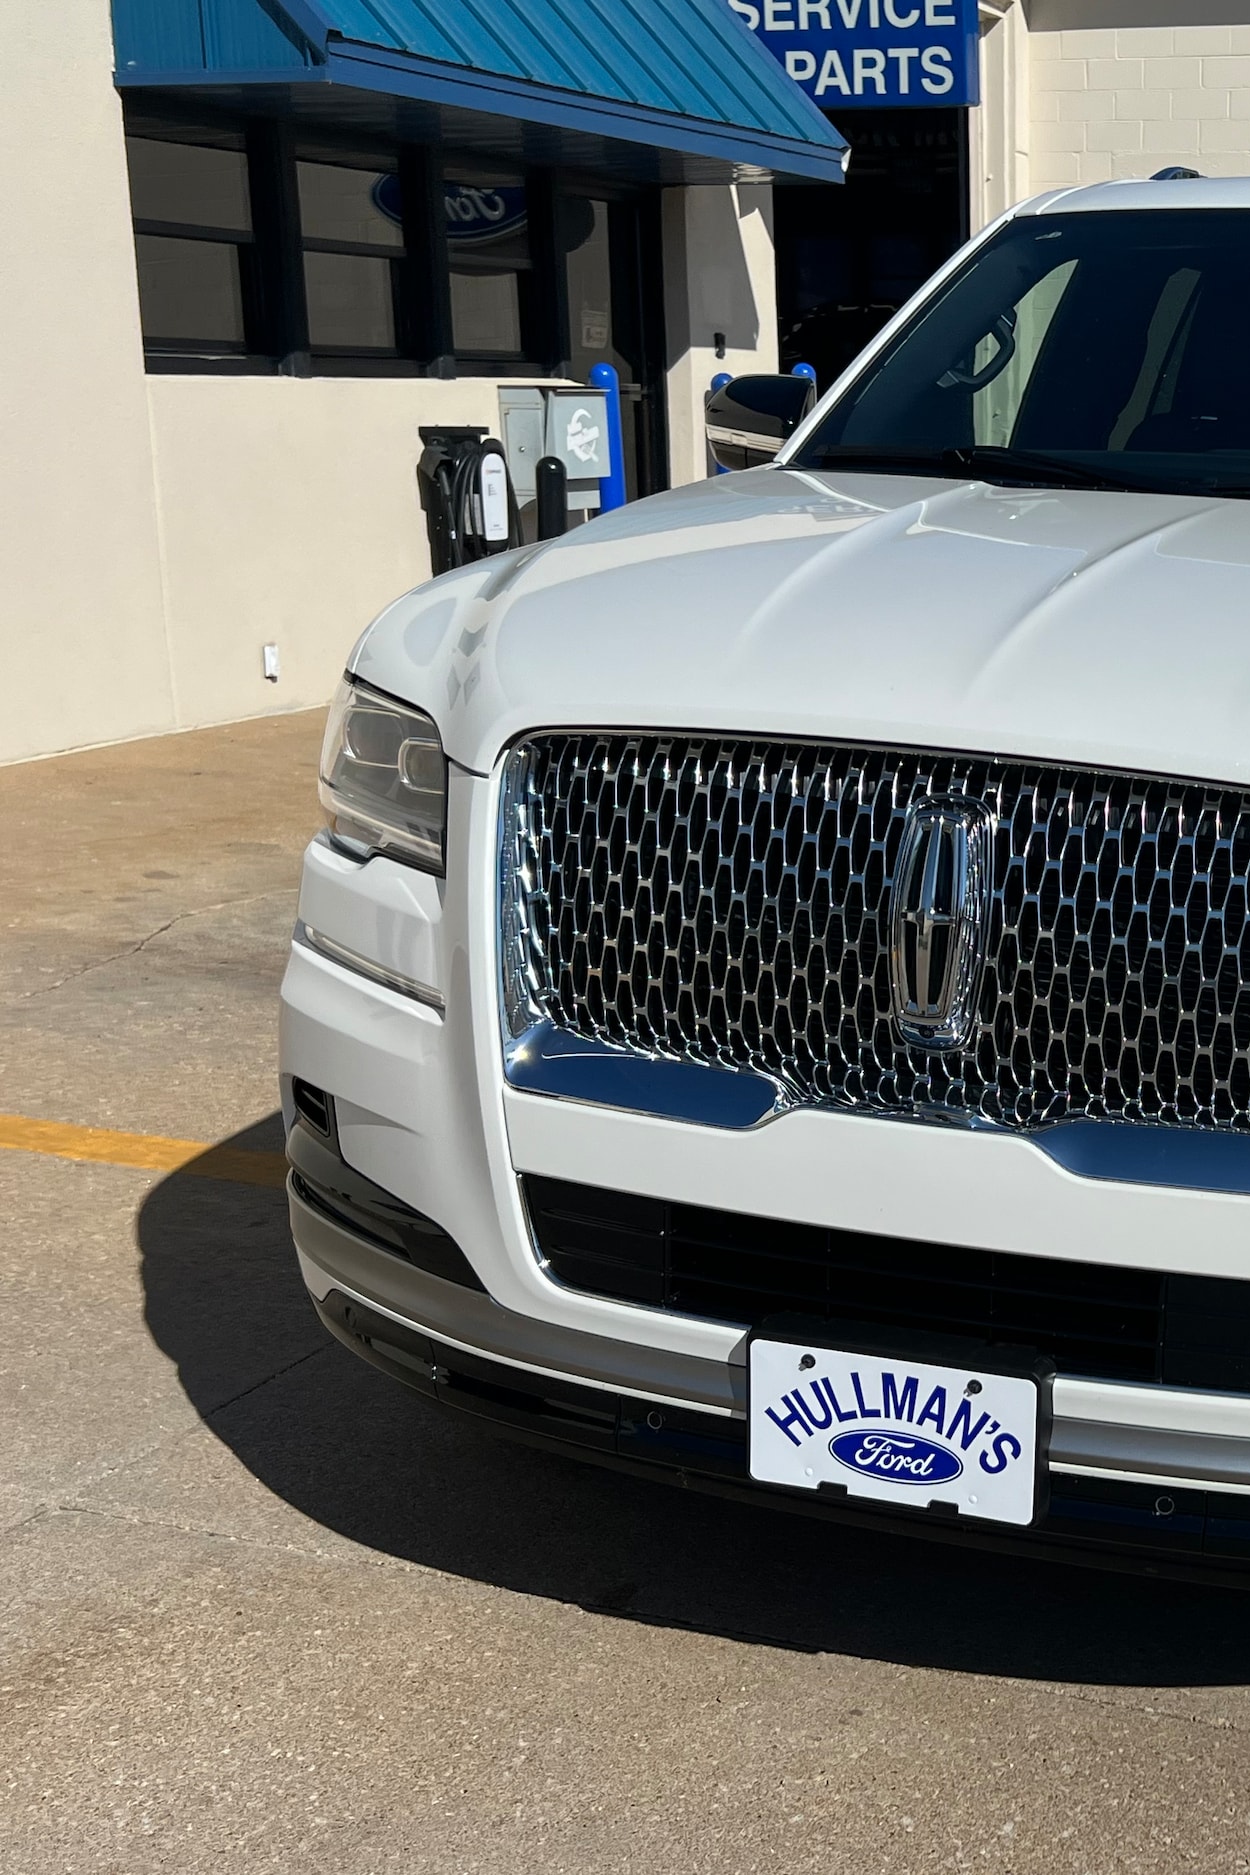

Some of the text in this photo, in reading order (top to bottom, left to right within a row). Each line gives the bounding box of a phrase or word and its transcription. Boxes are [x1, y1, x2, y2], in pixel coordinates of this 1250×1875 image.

[785, 46, 954, 96] PARTS
[764, 1372, 1022, 1475] HULLMAN'S
[854, 1435, 935, 1476] Ford
